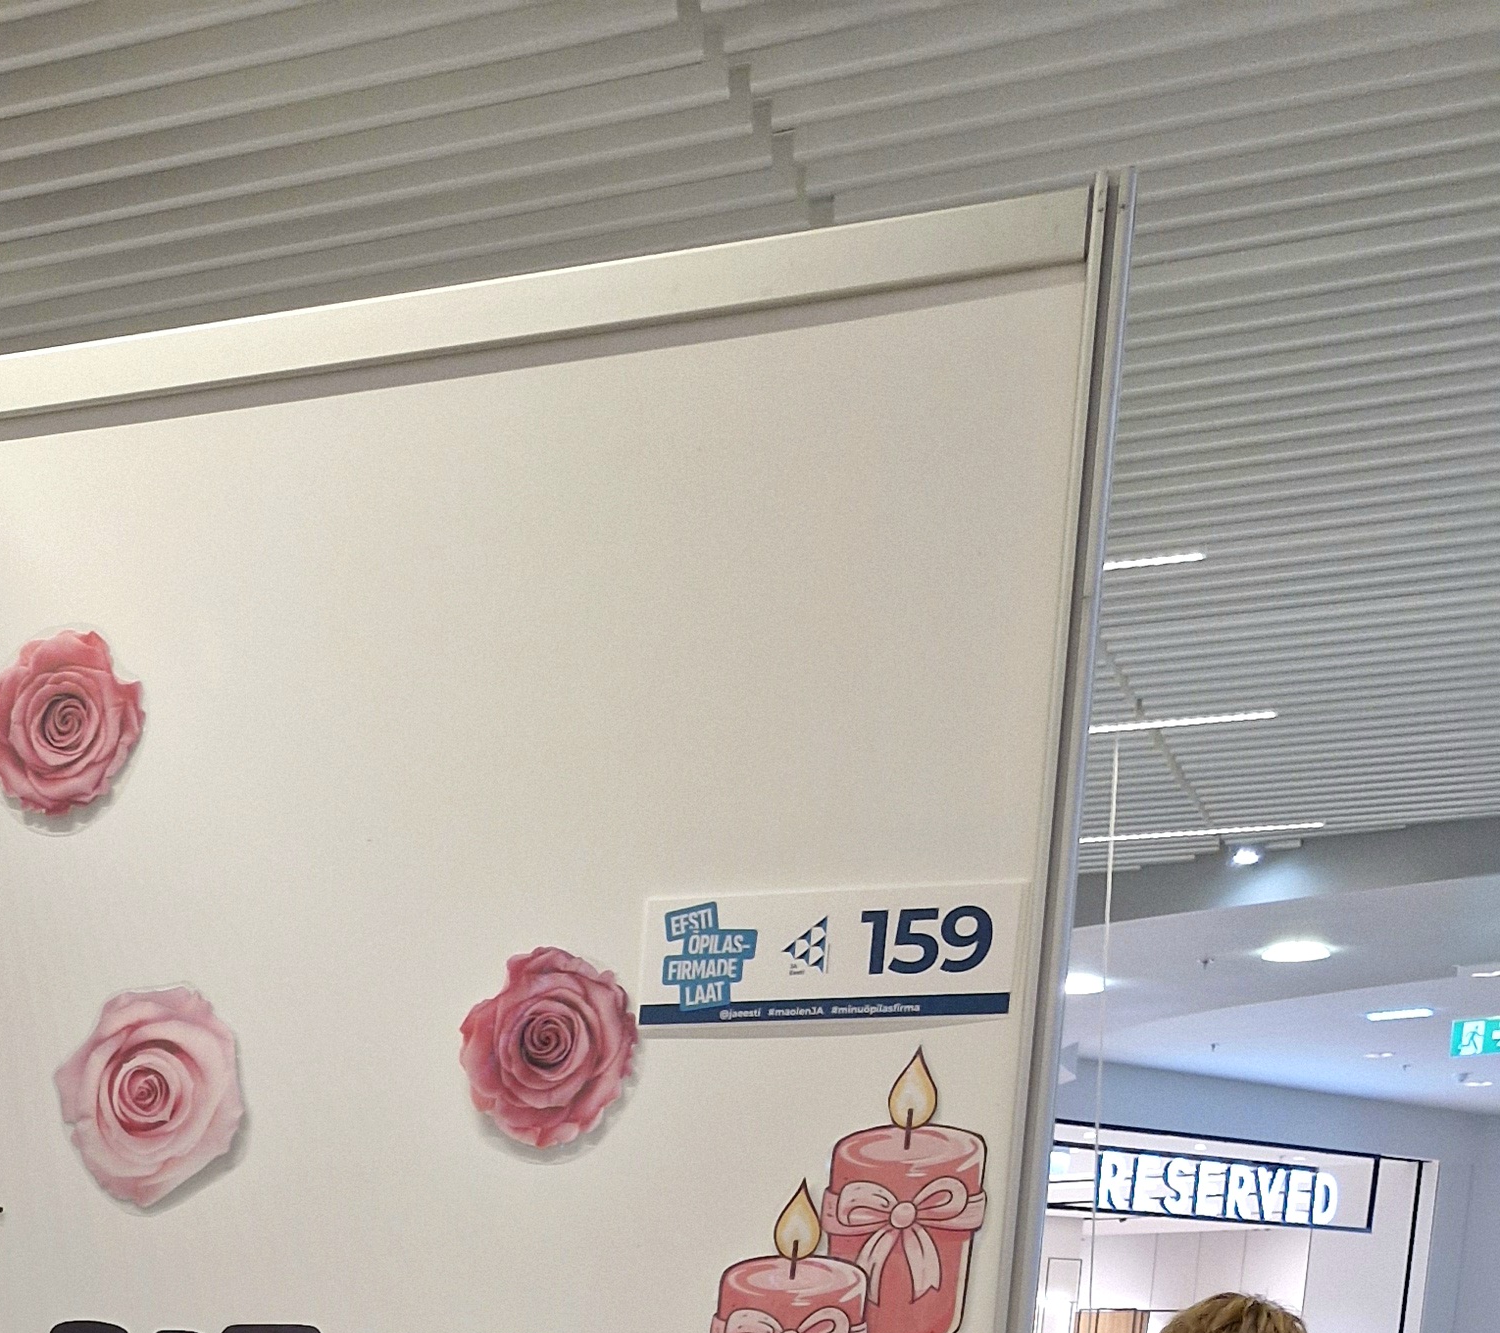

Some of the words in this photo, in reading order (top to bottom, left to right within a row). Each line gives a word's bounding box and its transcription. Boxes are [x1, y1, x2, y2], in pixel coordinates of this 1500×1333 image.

[688, 930, 750, 955] ÕPILAS-
[861, 905, 993, 975] 159
[667, 958, 737, 981] FIRMADE
[685, 981, 725, 1007] LAAT
[719, 1008, 761, 1020] @jaeesti
[1097, 1151, 1338, 1225] RESERVED
